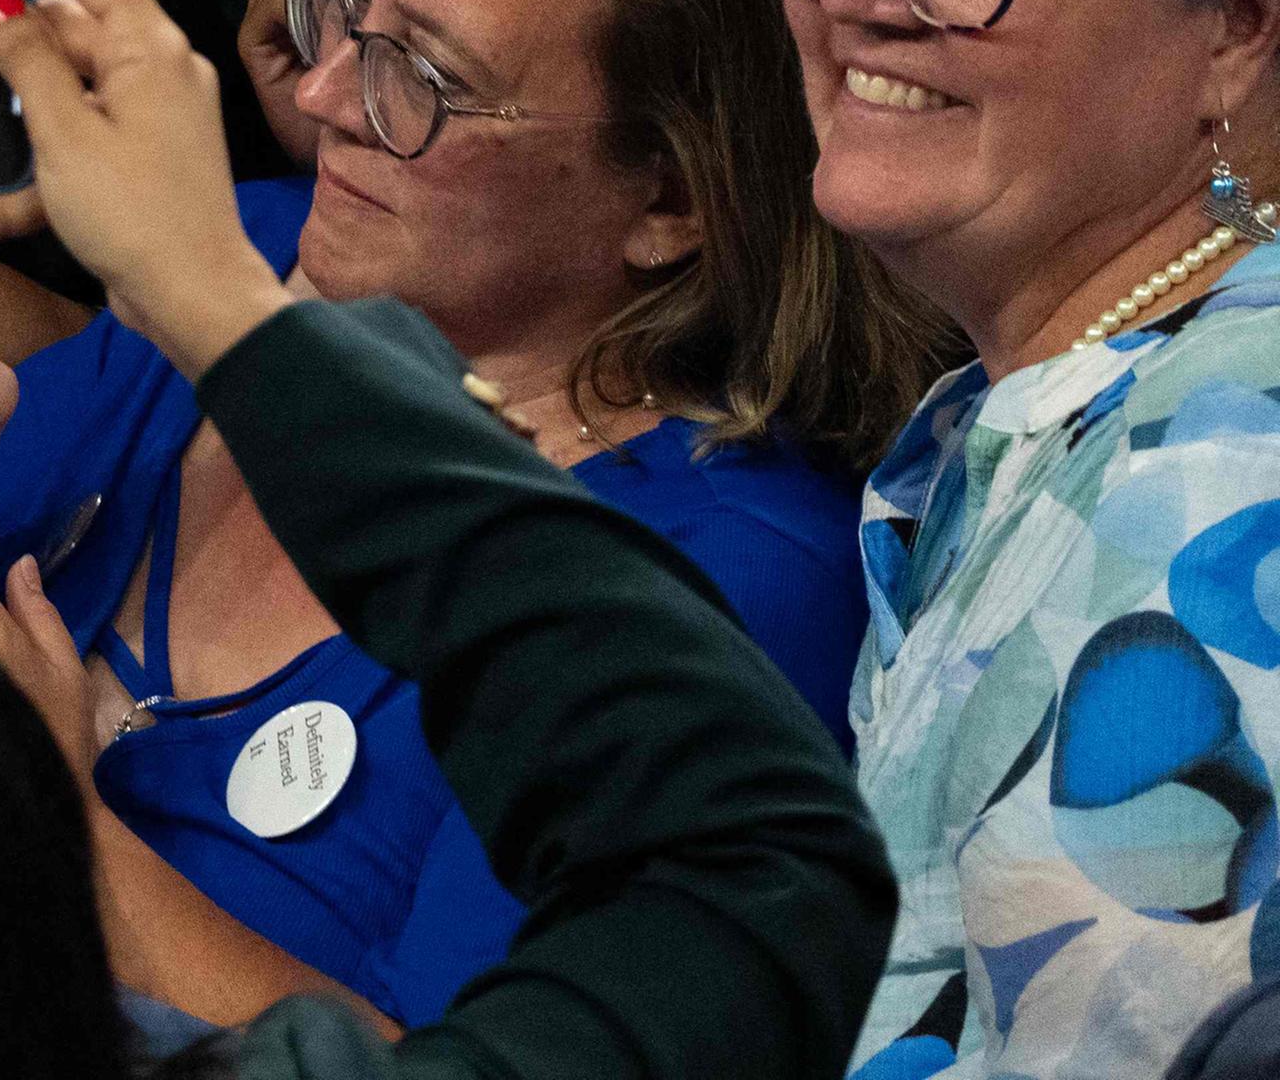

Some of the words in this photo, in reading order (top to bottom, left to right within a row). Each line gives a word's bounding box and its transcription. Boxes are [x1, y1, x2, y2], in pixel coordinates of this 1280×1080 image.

[250, 739, 266, 761] It
[277, 726, 298, 787] Earned
[305, 711, 328, 790] Definitely
